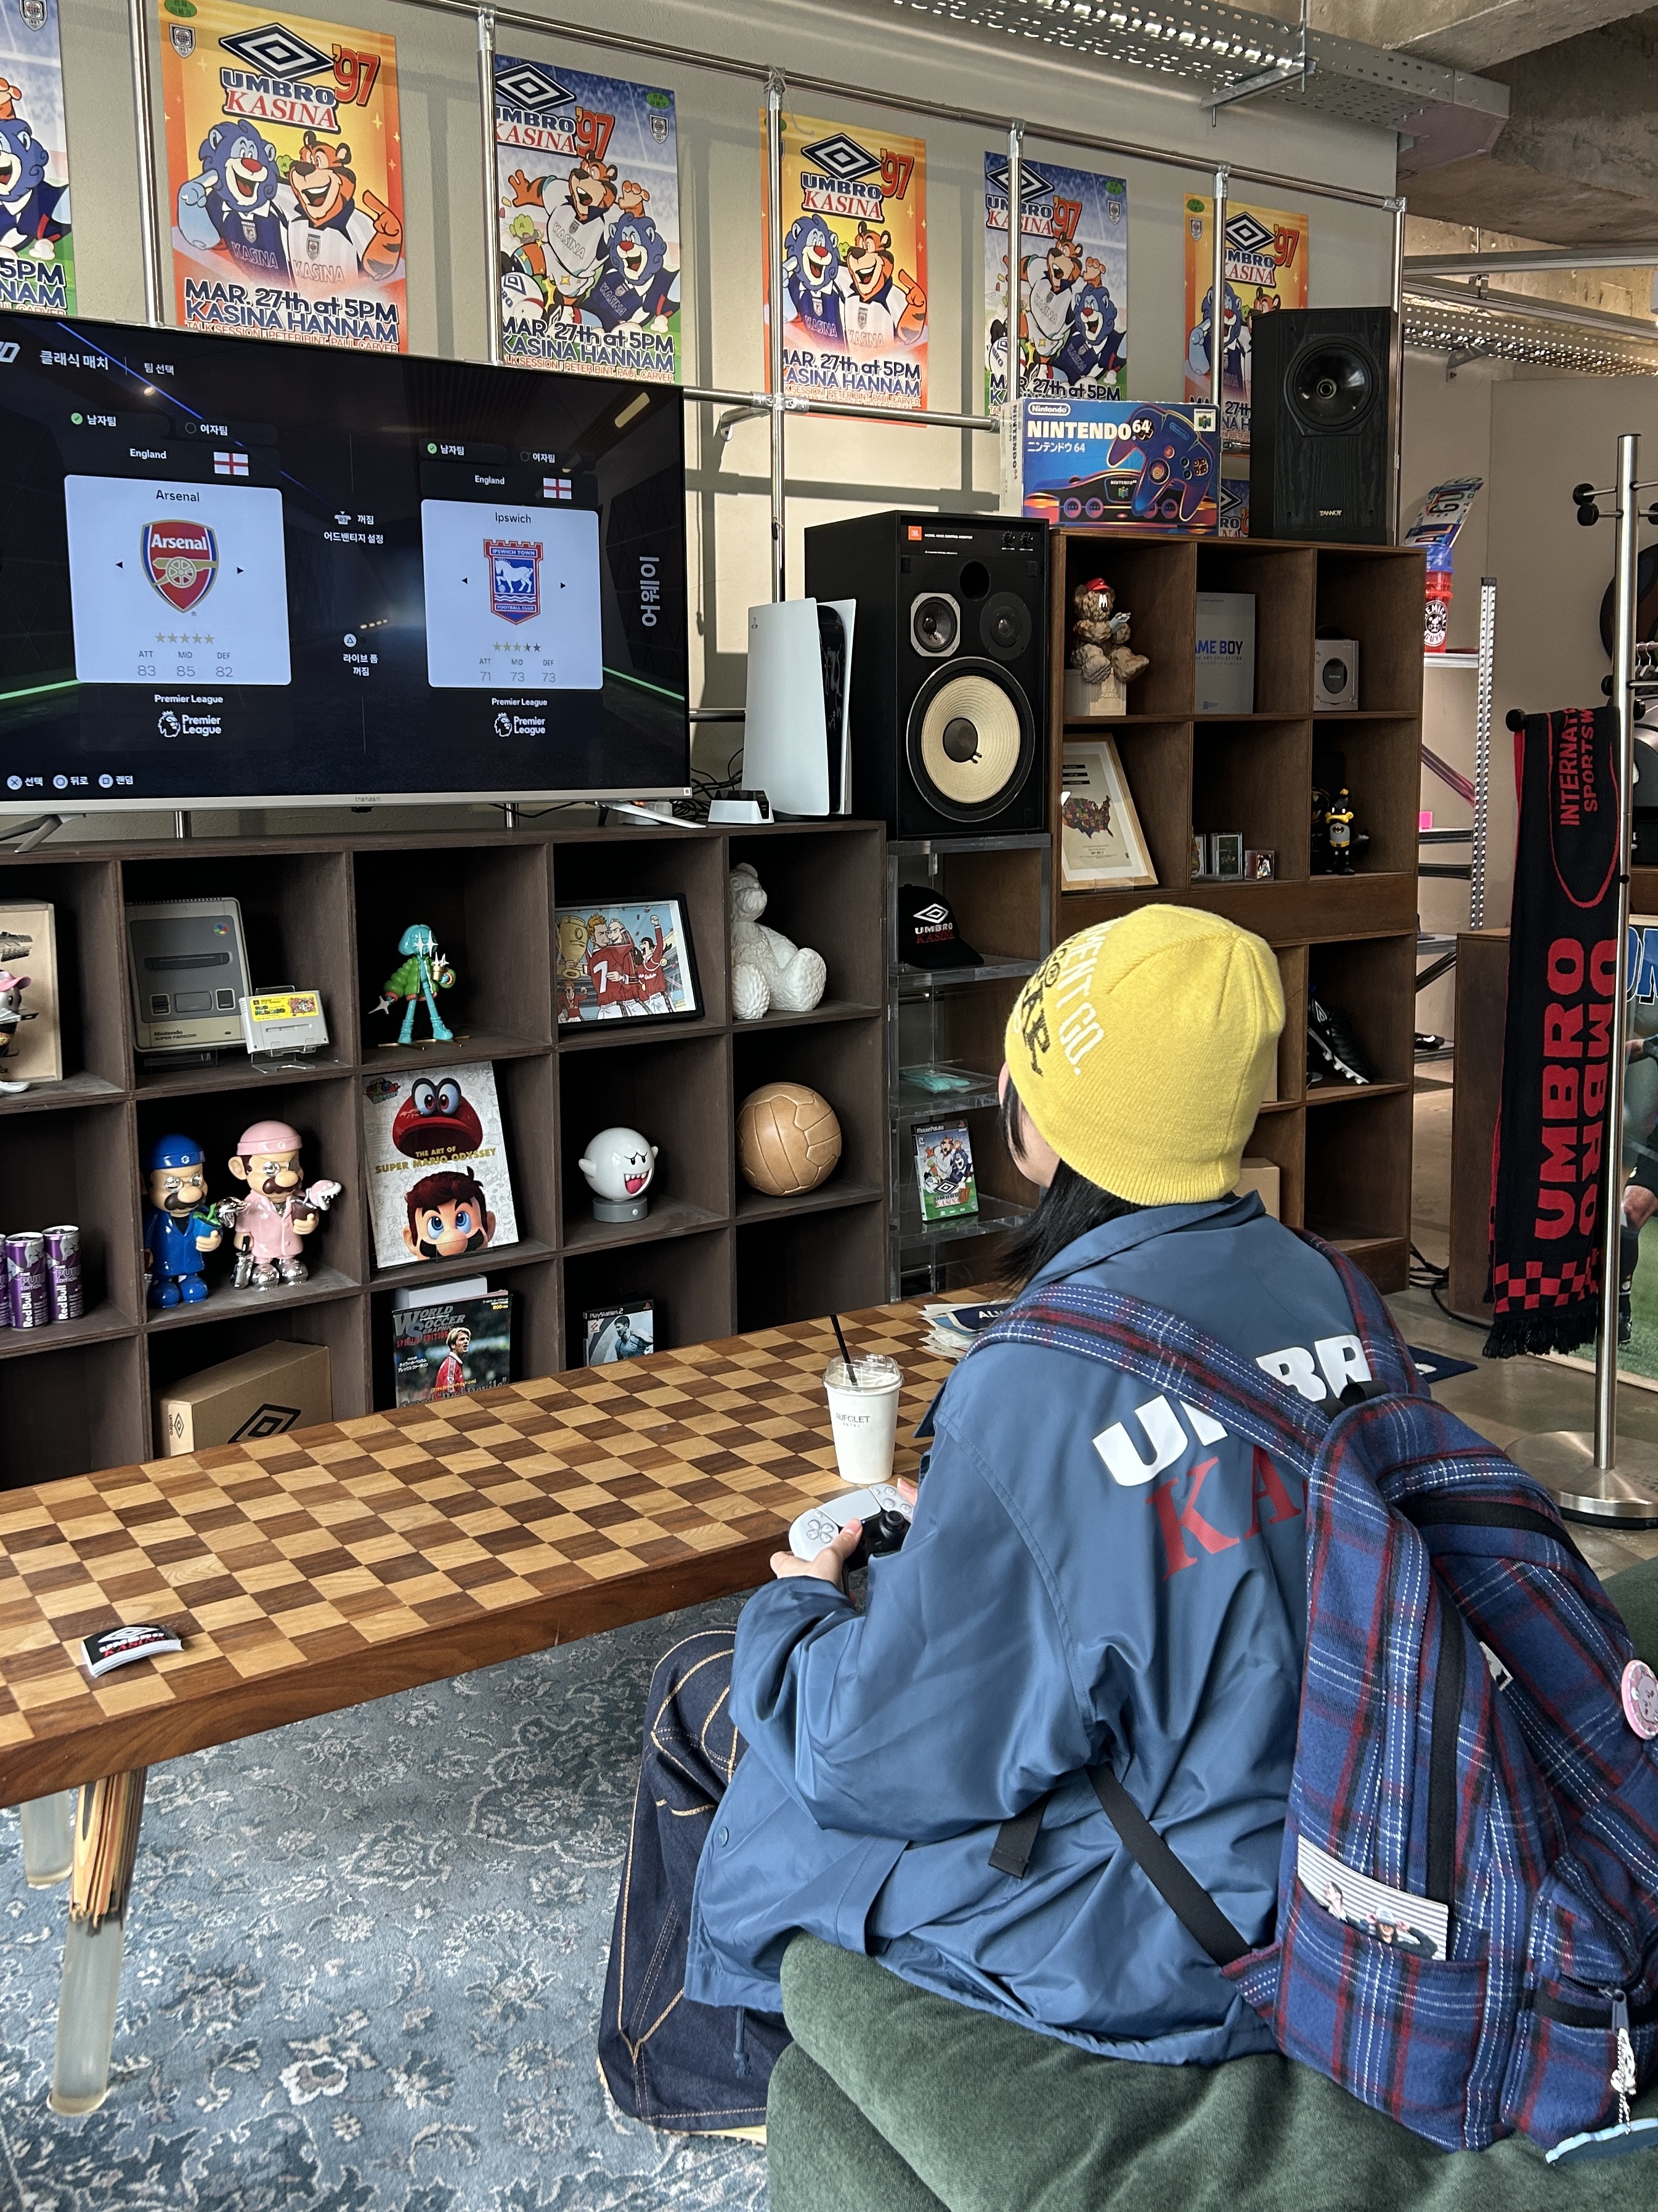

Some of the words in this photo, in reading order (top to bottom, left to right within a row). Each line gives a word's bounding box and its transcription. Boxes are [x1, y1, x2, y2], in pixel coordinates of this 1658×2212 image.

[331, 43, 381, 107] '97
[222, 69, 337, 106] UMBRO
[226, 89, 336, 129] KASINA
[575, 106, 615, 161] '97
[880, 148, 914, 200] '97
[802, 173, 882, 200] UMBRO
[804, 189, 881, 219] KASINA
[1054, 195, 1082, 240] '97
[553, 222, 585, 259] KASINA
[1274, 224, 1299, 267] '97
[230, 241, 278, 269] KASINA
[0, 257, 65, 286] 5PM
[293, 259, 345, 284] KASINA
[185, 278, 251, 307] MAR.
[255, 288, 311, 313] 27th
[311, 297, 340, 315] at
[344, 299, 399, 324] 5PM
[599, 282, 627, 317] KASINA
[1034, 293, 1057, 325] KASINA
[185, 300, 285, 330] KASINA
[287, 311, 399, 344] HANNAM
[215, 323, 261, 338] SESSION
[805, 315, 838, 338] KASINA
[555, 323, 601, 346] 27th
[603, 331, 627, 347] at
[629, 333, 675, 355] 5PM
[847, 328, 885, 349] KASINA
[40, 350, 80, 367] 클래식
[83, 355, 108, 370] 매치
[580, 343, 675, 373] HANNAM
[821, 354, 858, 373] 27th
[861, 359, 880, 375] at
[883, 361, 921, 381] 5PM
[1067, 343, 1087, 372] KASINA
[144, 363, 153, 374] 팀
[156, 363, 174, 376] 선택
[519, 356, 558, 370] SESSION
[565, 362, 593, 373] PETER
[617, 368, 639, 378] PAUL
[642, 371, 674, 383] CARVER
[784, 367, 840, 389] ASINA
[842, 373, 921, 398] HANNAM
[990, 373, 1030, 393] MR.
[1033, 378, 1067, 397] 27th
[1068, 384, 1086, 399] at
[1087, 385, 1121, 401] 5PM
[792, 386, 824, 396] SESSION
[829, 390, 853, 399] PETER
[872, 394, 891, 403] PAUL
[892, 396, 921, 407] CARVER
[1031, 405, 1068, 413] Nintendo
[87, 415, 116, 427] 남자팀
[200, 424, 228, 436] 여자팀
[1027, 420, 1132, 440] NINTENDO
[129, 448, 167, 460] England
[440, 444, 465, 456] 남자팀
[532, 452, 555, 463] 여자팀
[1027, 442, 1072, 453] ニンテンドウ
[1074, 443, 1086, 453] 64
[474, 475, 505, 485] England
[155, 490, 200, 502] Arsenal
[357, 514, 375, 525] 꺼짐
[495, 512, 532, 524] Ipswich
[151, 533, 208, 551] Arsenal
[368, 534, 384, 544] 설정
[1424, 633, 1444, 642] GUYS
[1220, 641, 1243, 655] BOY
[343, 654, 368, 664] 라이브
[137, 665, 156, 676] 83
[177, 666, 196, 677] 85
[216, 666, 234, 678] 82
[352, 666, 369, 676] 꺼짐
[480, 671, 491, 681] 71
[510, 672, 524, 682] 73
[542, 672, 556, 683] 73
[154, 694, 190, 703] Premier
[191, 695, 224, 705] League
[492, 697, 520, 705] Premier
[521, 698, 548, 708] League
[182, 715, 221, 725] Premier
[513, 716, 545, 726] Premier
[514, 724, 546, 736] League
[182, 725, 222, 737] League
[25, 777, 44, 787] 선택
[70, 776, 89, 785] 뒤로
[915, 922, 953, 934] UMBRO
[1059, 1002, 1105, 1076] CO.
[1535, 938, 1584, 1240] UMBRO
[375, 1162, 408, 1173] SUPER
[413, 1155, 448, 1168] MARIO
[451, 1148, 496, 1161] ODYSSEY
[935, 1199, 961, 1208] KASINA
[393, 1305, 453, 1337] WORLD
[590, 1310, 618, 1319] PlayStation
[407, 1315, 466, 1345] SOCCER
[396, 1337, 421, 1348] SPECIAL
[836, 1412, 871, 1423] AUFGLET
[104, 1636, 166, 1658] KASINA
